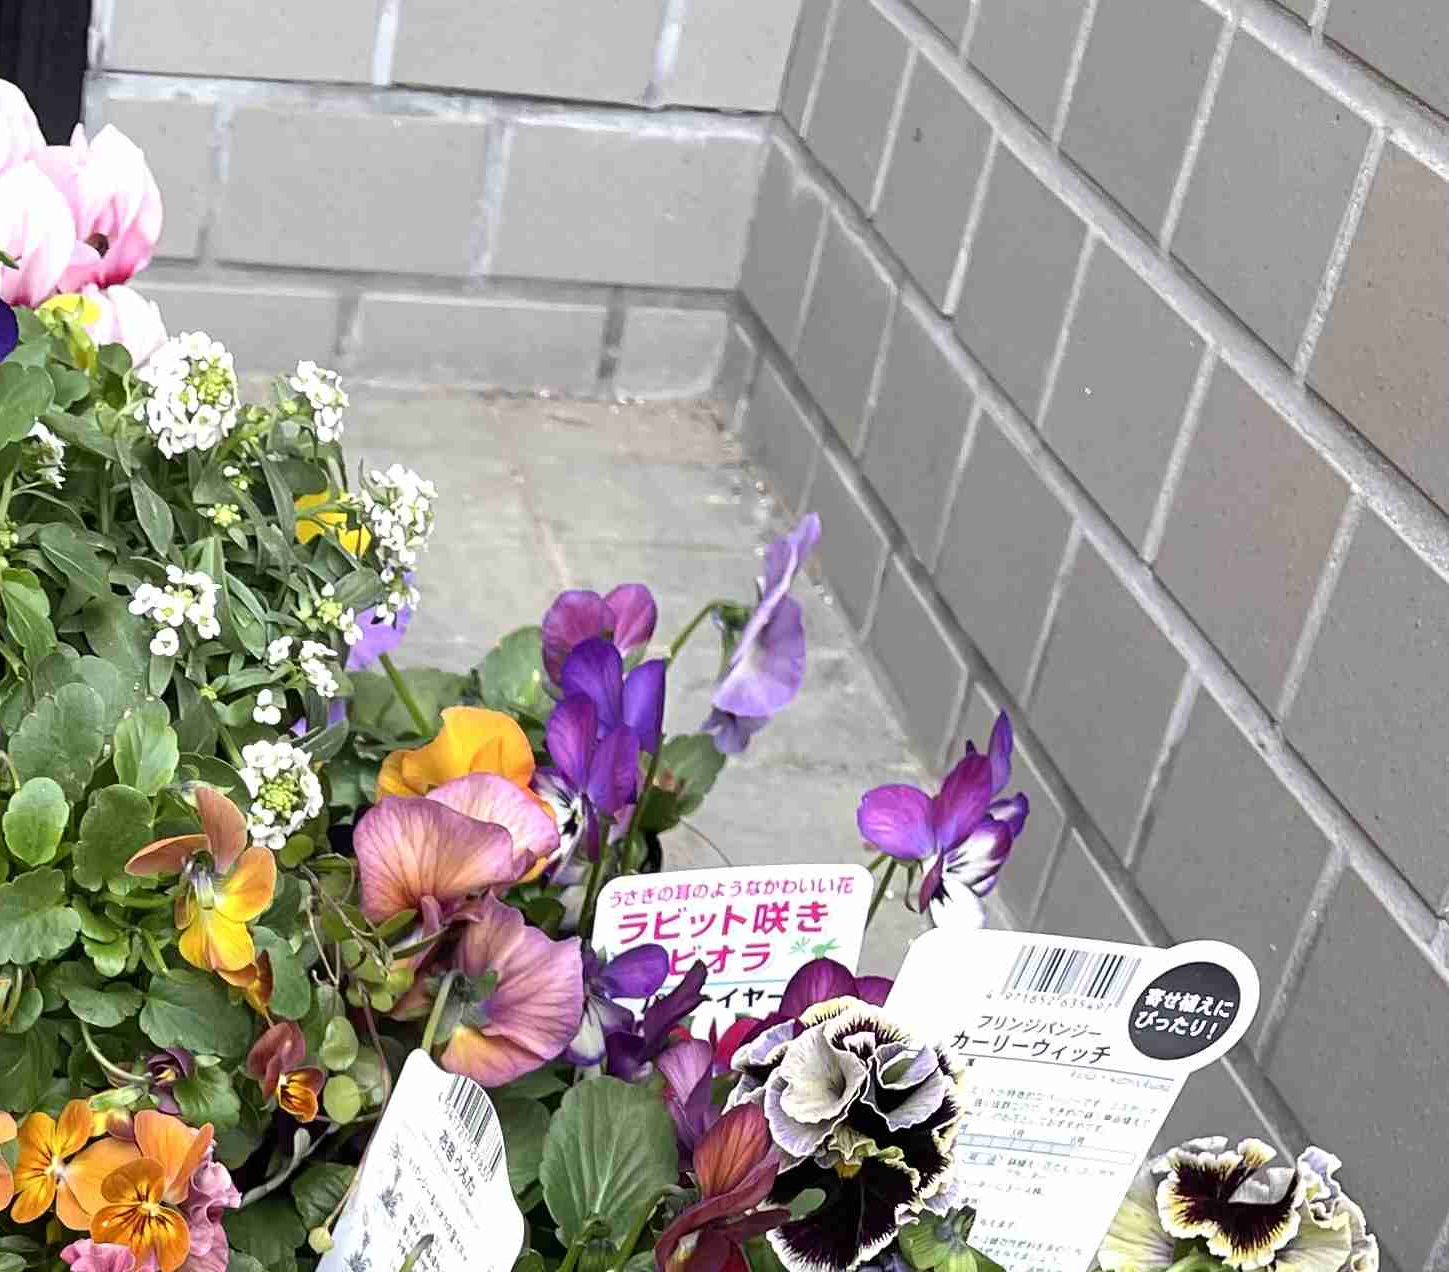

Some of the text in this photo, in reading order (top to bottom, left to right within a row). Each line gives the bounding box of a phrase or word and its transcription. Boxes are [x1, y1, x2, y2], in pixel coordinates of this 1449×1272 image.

[610, 876, 854, 908] うさぎの耳のようなかわいい花
[618, 901, 829, 945] ラビット咲き
[669, 943, 774, 977] ビオラ
[1144, 987, 1234, 1018] 寄せ植えに
[976, 1014, 1102, 1039] フリンジパンジー
[950, 1031, 1111, 1064] カーリーウィッチ
